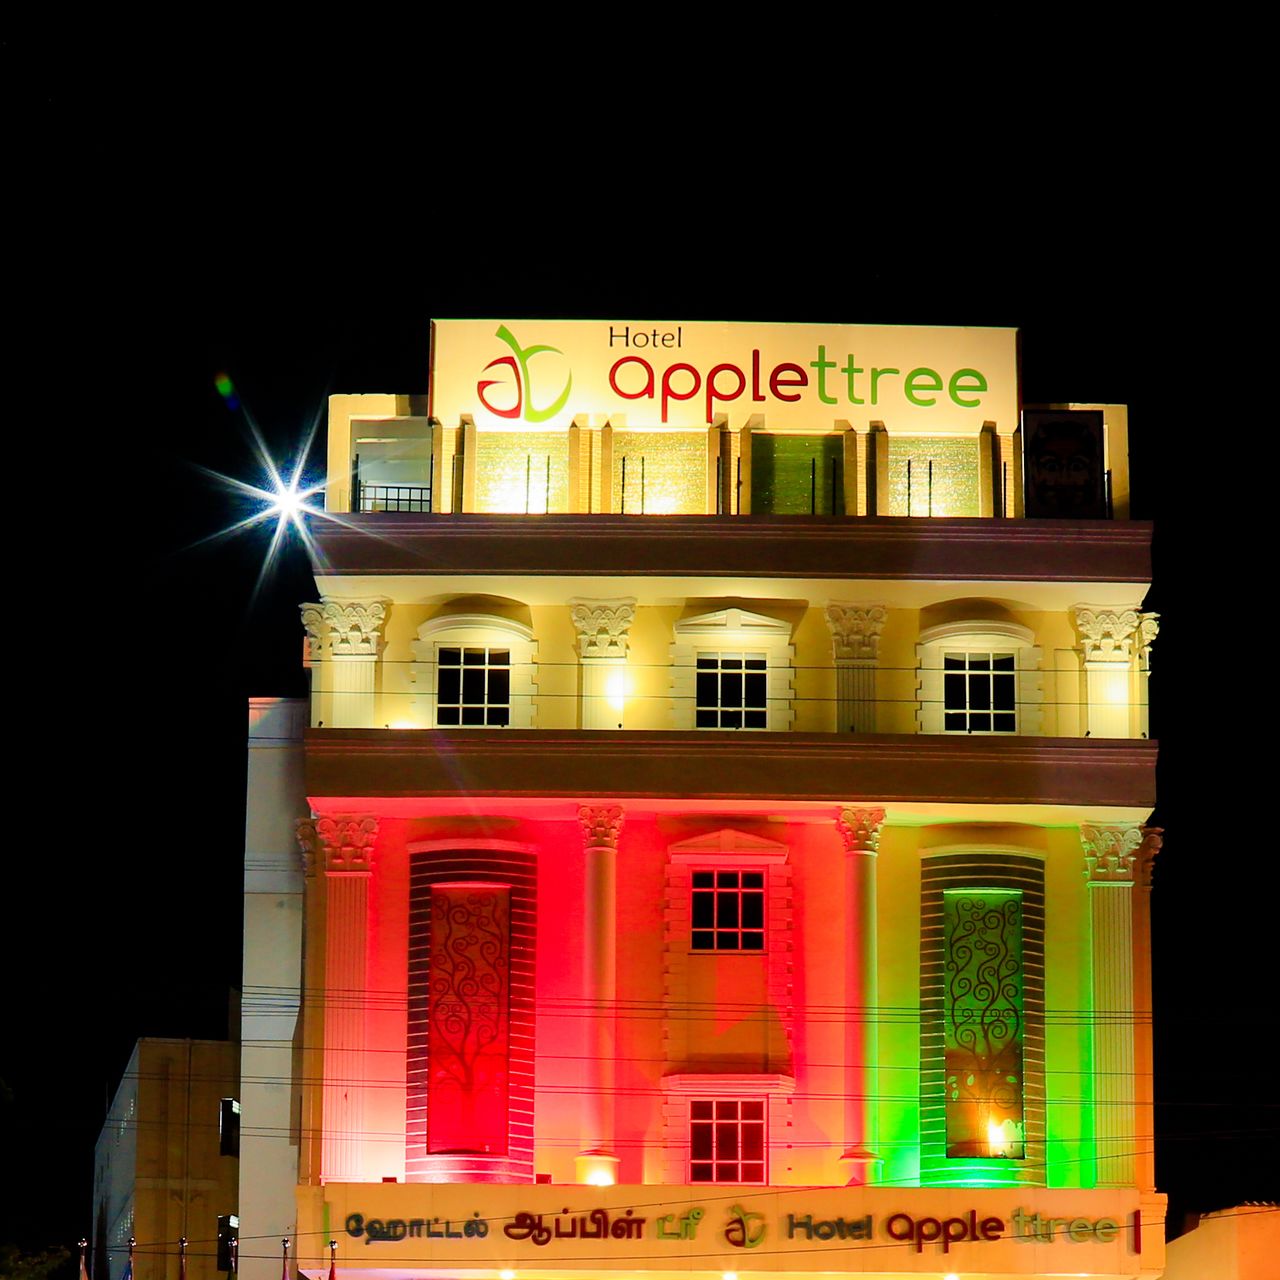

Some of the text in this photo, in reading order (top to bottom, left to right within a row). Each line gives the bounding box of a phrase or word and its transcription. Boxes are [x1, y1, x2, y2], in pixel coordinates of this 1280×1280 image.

[608, 325, 683, 349] Hotel
[344, 1211, 489, 1245] ஹோட்டல்
[502, 1208, 647, 1246] ஆப்பிள்
[787, 1213, 873, 1241] Hotel
